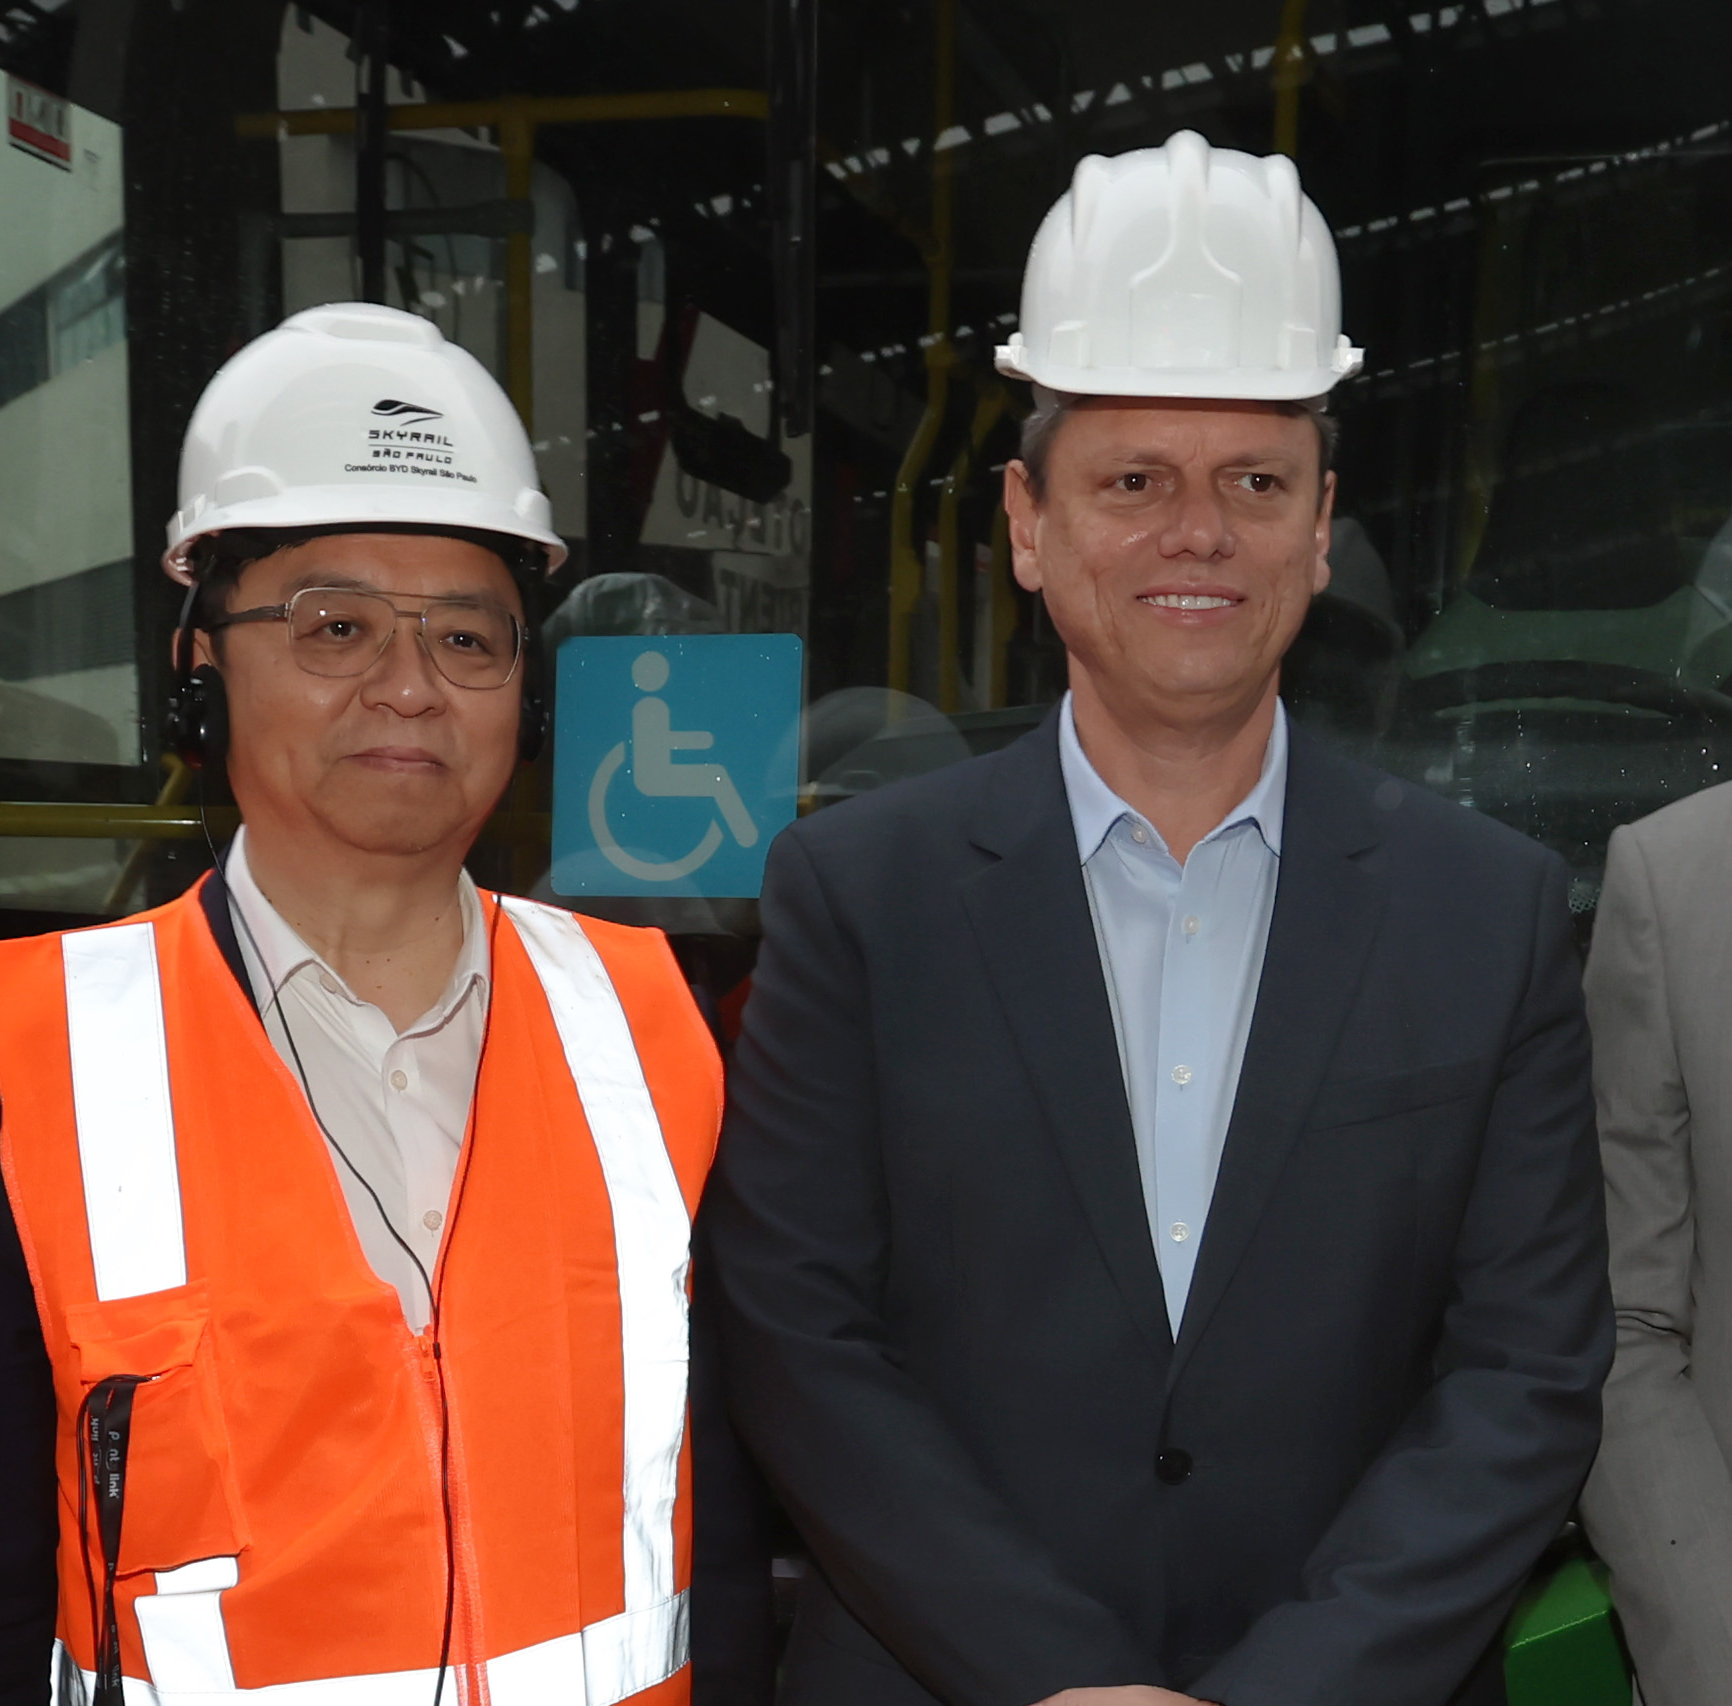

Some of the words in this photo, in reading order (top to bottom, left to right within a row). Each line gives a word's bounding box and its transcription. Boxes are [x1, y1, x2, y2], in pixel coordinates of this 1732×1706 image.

[368, 429, 454, 447] SKYRAIL
[372, 447, 401, 459] SÃO
[406, 452, 453, 464] PAULO
[344, 463, 387, 473] Consórcio
[389, 464, 409, 473] BYD
[411, 465, 438, 477] Skyrail
[439, 468, 455, 479] São
[456, 471, 477, 483] Paulo
